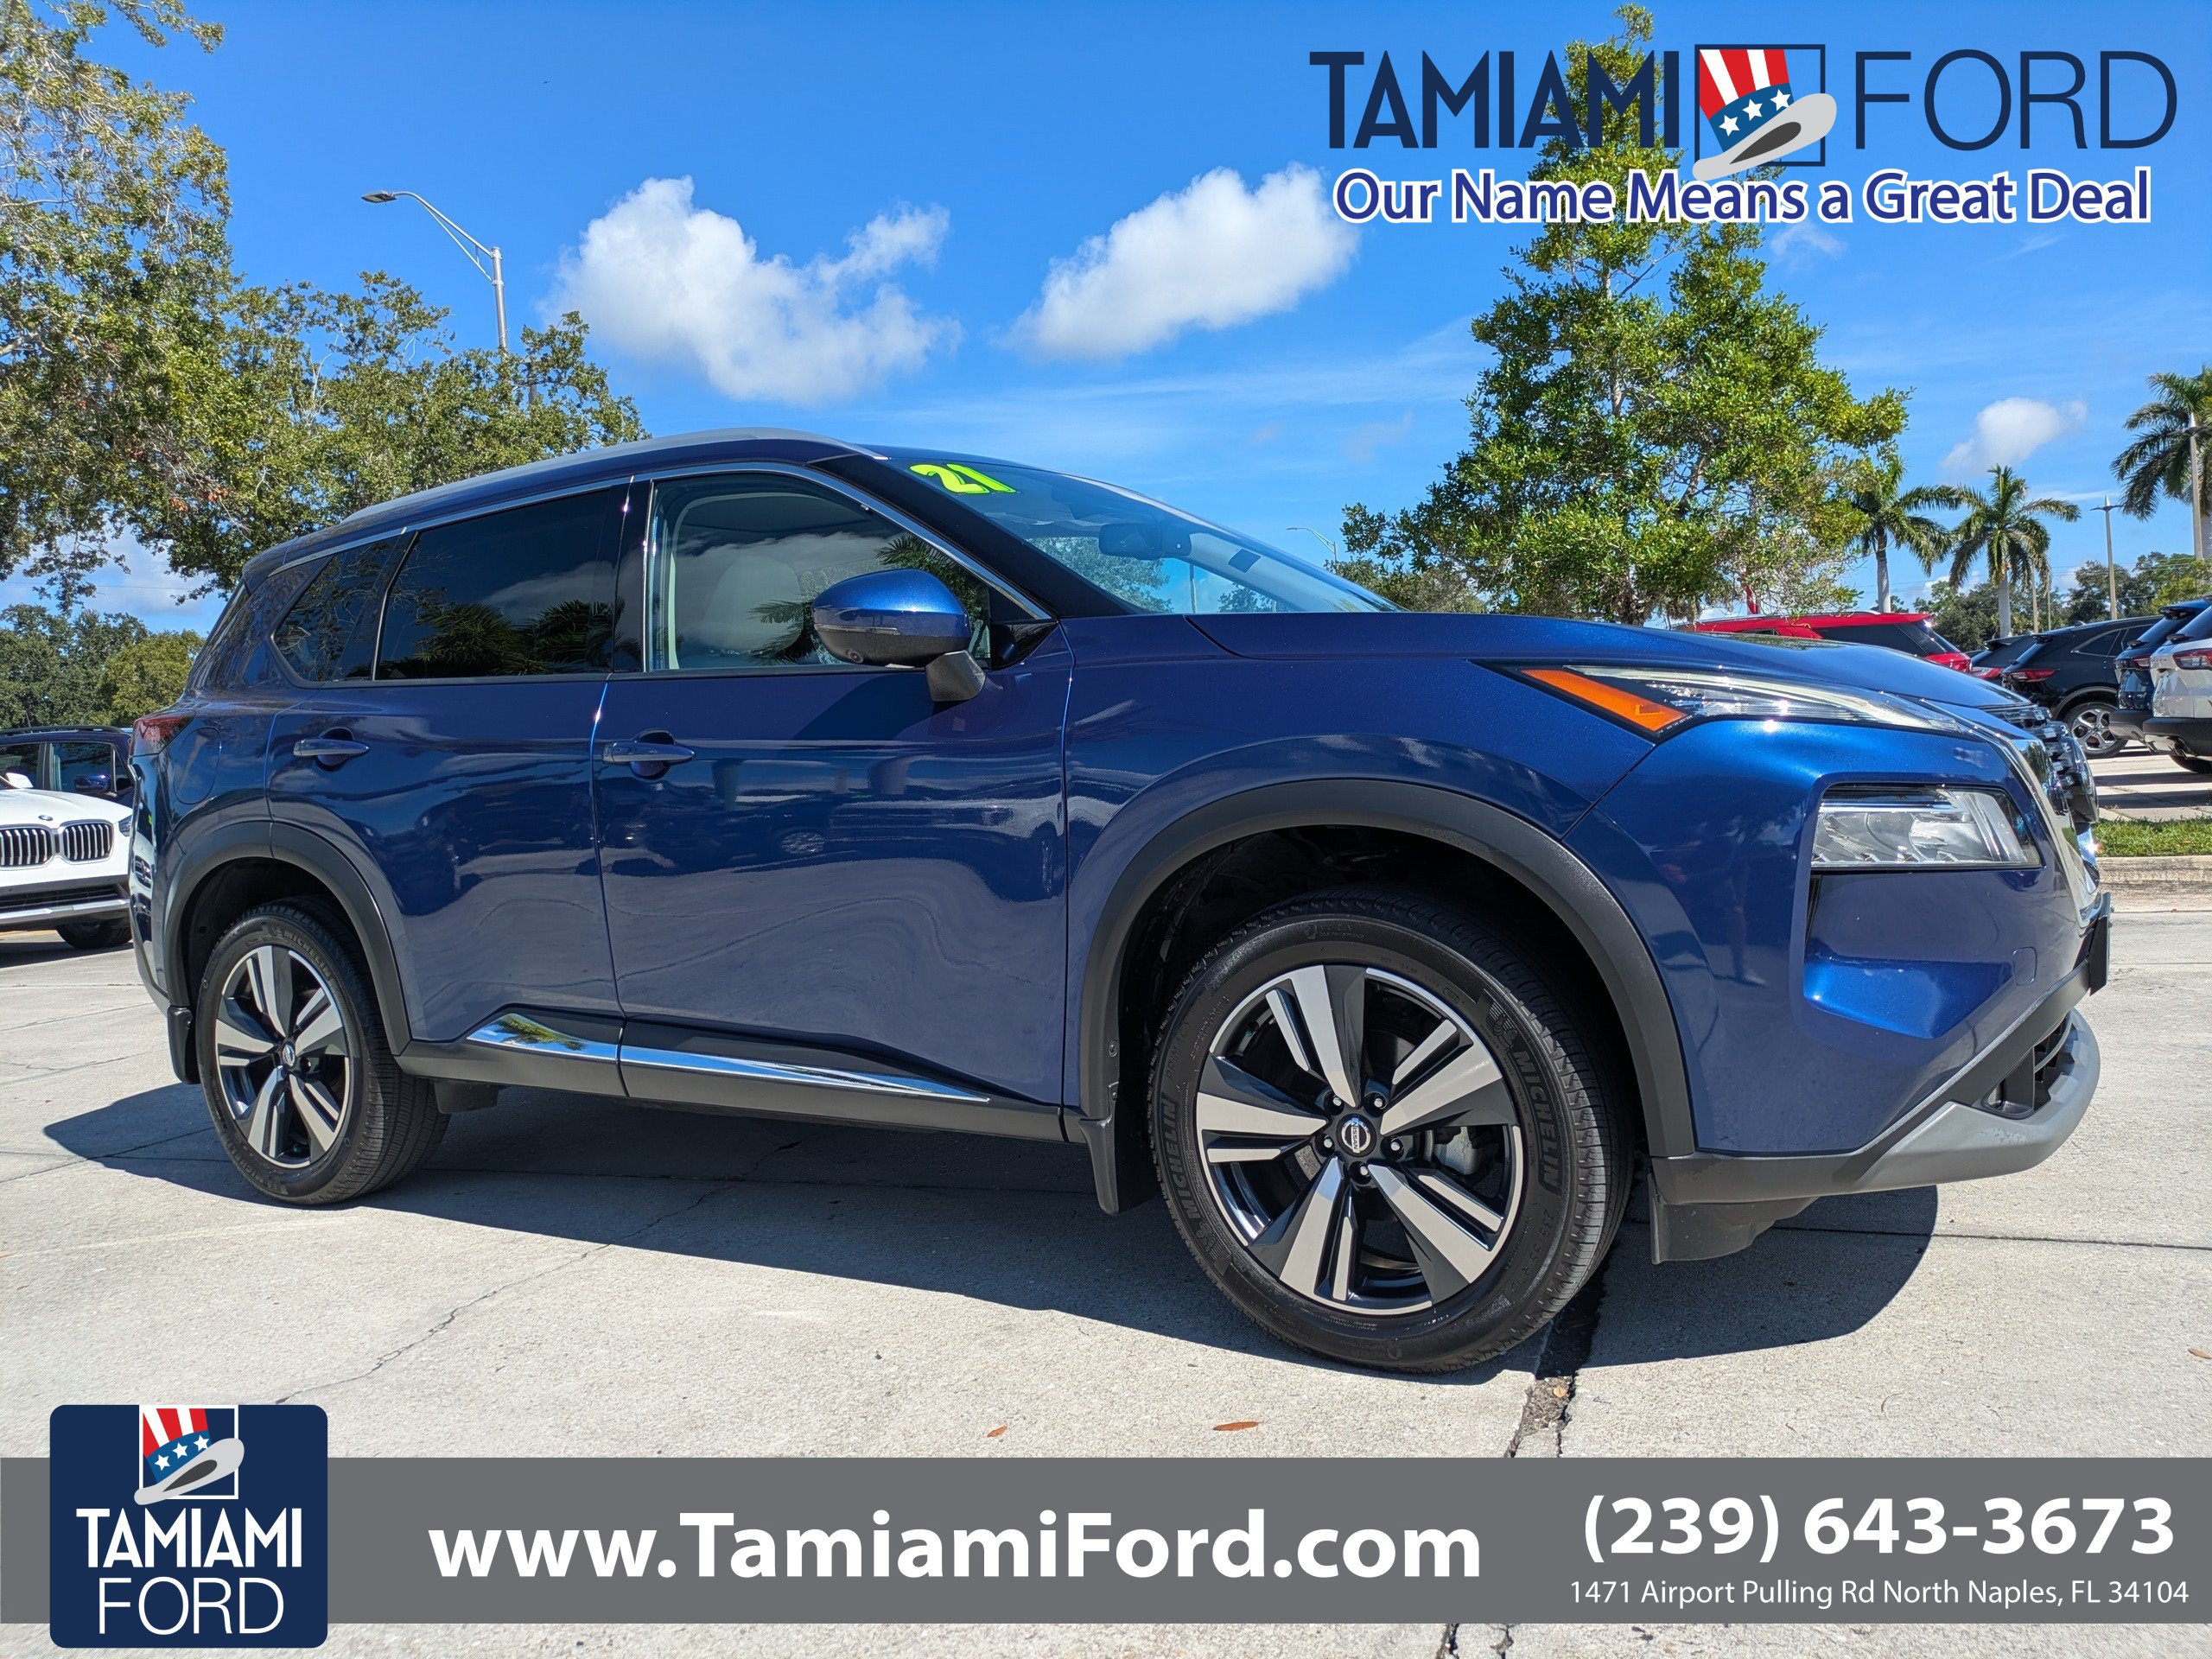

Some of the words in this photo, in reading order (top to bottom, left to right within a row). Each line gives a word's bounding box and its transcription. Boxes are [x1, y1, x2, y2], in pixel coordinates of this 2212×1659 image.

[910, 463, 1017, 494] 21
[1162, 1098, 1202, 1220] MICHELIN
[1513, 1051, 1560, 1189] MICHELIN
